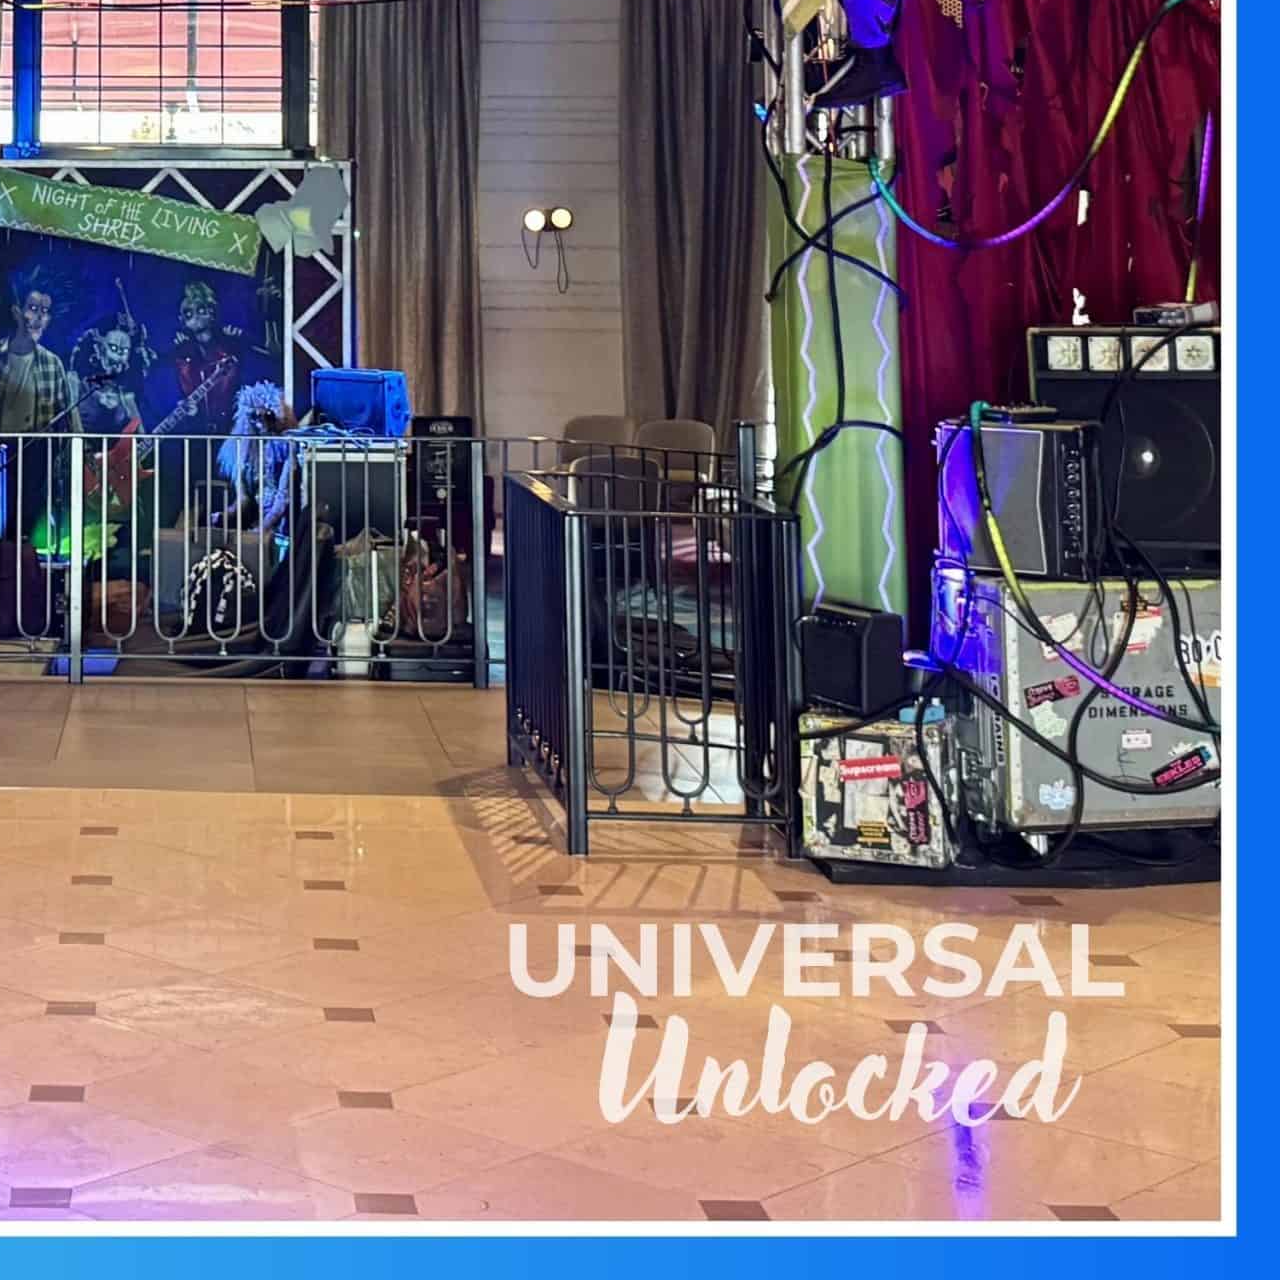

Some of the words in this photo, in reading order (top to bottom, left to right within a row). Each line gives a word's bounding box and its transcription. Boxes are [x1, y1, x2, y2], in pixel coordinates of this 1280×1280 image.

[31, 182, 93, 212] NIGHT
[152, 207, 221, 239] LIVING
[78, 213, 146, 245] SHRED
